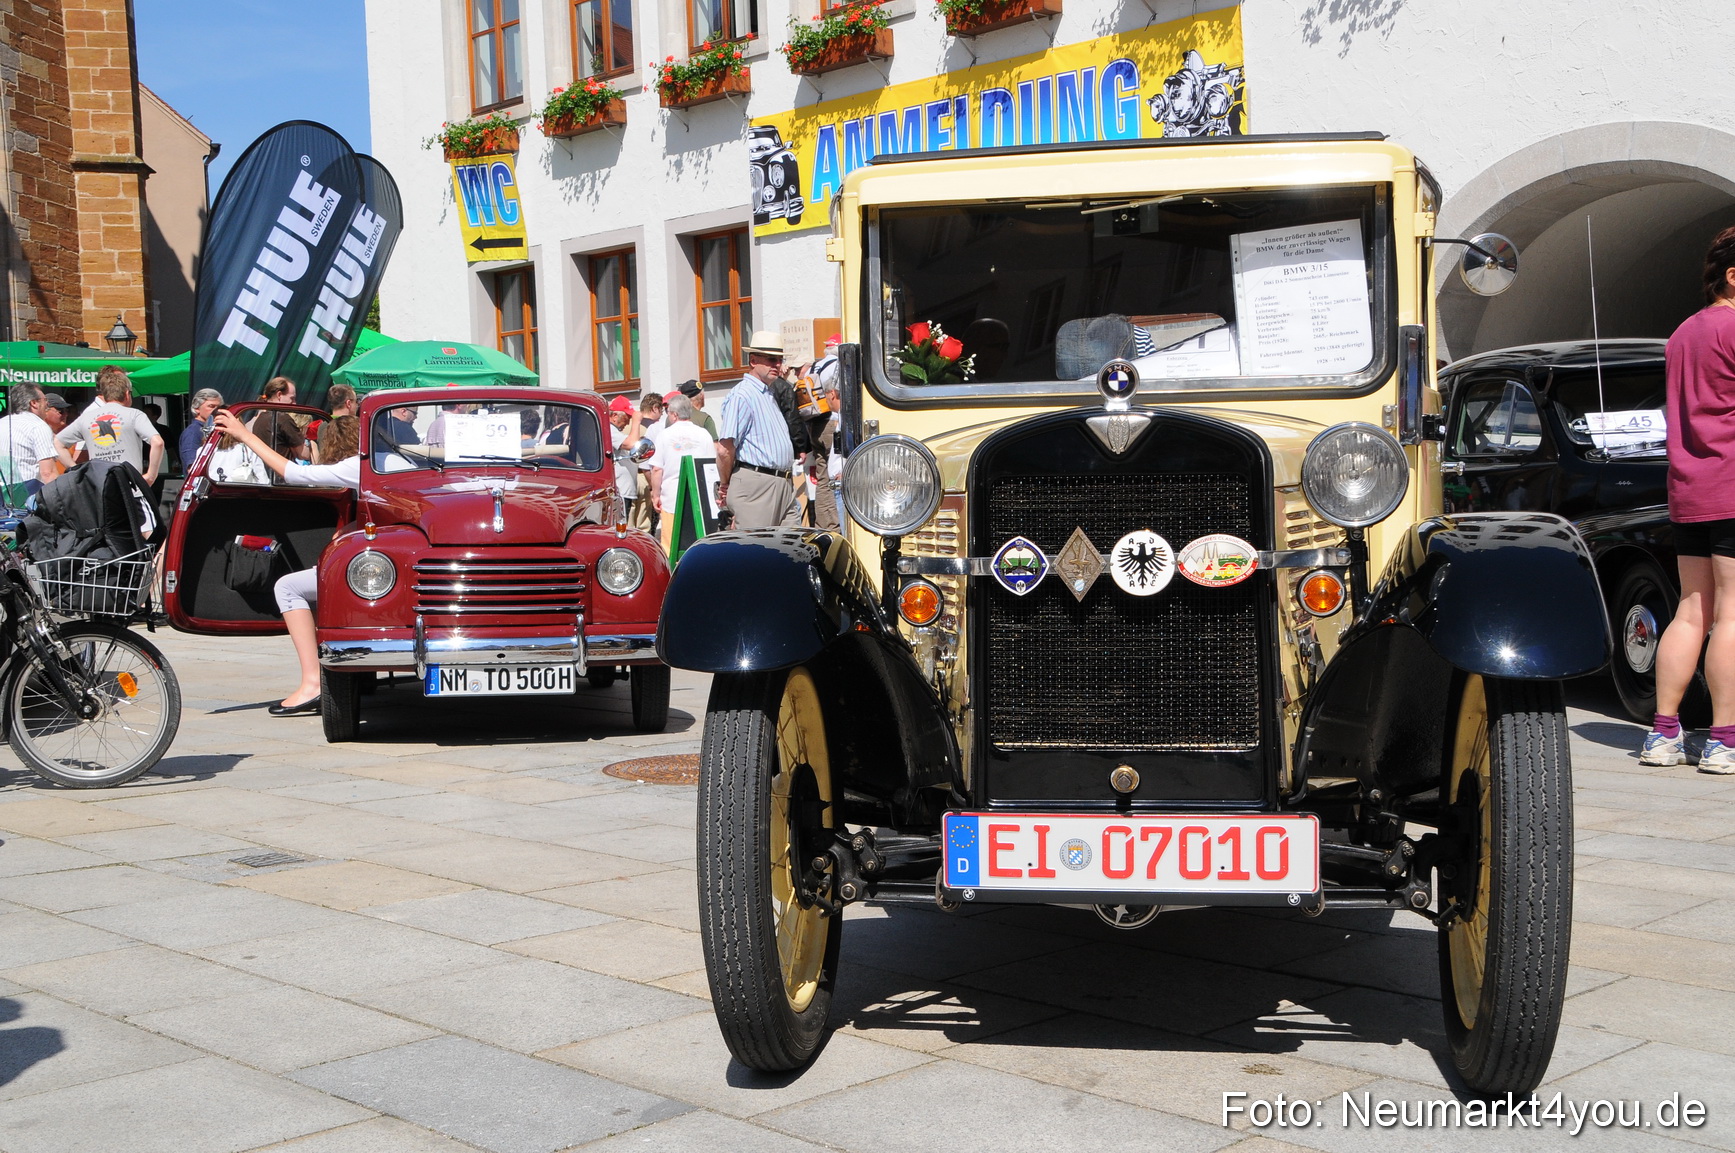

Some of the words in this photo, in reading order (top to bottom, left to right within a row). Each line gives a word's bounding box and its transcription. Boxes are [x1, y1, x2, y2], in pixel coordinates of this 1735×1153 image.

[455, 161, 519, 227] WC
[310, 195, 335, 237] SWEDEN
[364, 221, 382, 259] SWEDEN
[1256, 244, 1274, 253] BMW
[1288, 239, 1327, 249] zuverlässige
[1328, 236, 1351, 244] Wagen
[1284, 233, 1306, 242] größer
[1306, 247, 1325, 255] Dame
[217, 169, 342, 356] THULE
[1283, 266, 1308, 276] BMW
[1310, 263, 1329, 273] 3/15
[298, 203, 387, 365] THULE
[0, 367, 98, 383] Neumarkter
[1107, 364, 1131, 373] BMW
[358, 376, 407, 388] Lammsbräu
[1628, 415, 1653, 428] 45
[429, 683, 436, 691] D
[440, 668, 468, 692] NM
[483, 667, 511, 691] TO
[517, 666, 571, 691] 500H
[957, 857, 970, 873] D
[988, 823, 1056, 879] EI
[1101, 825, 1290, 881] 07010
